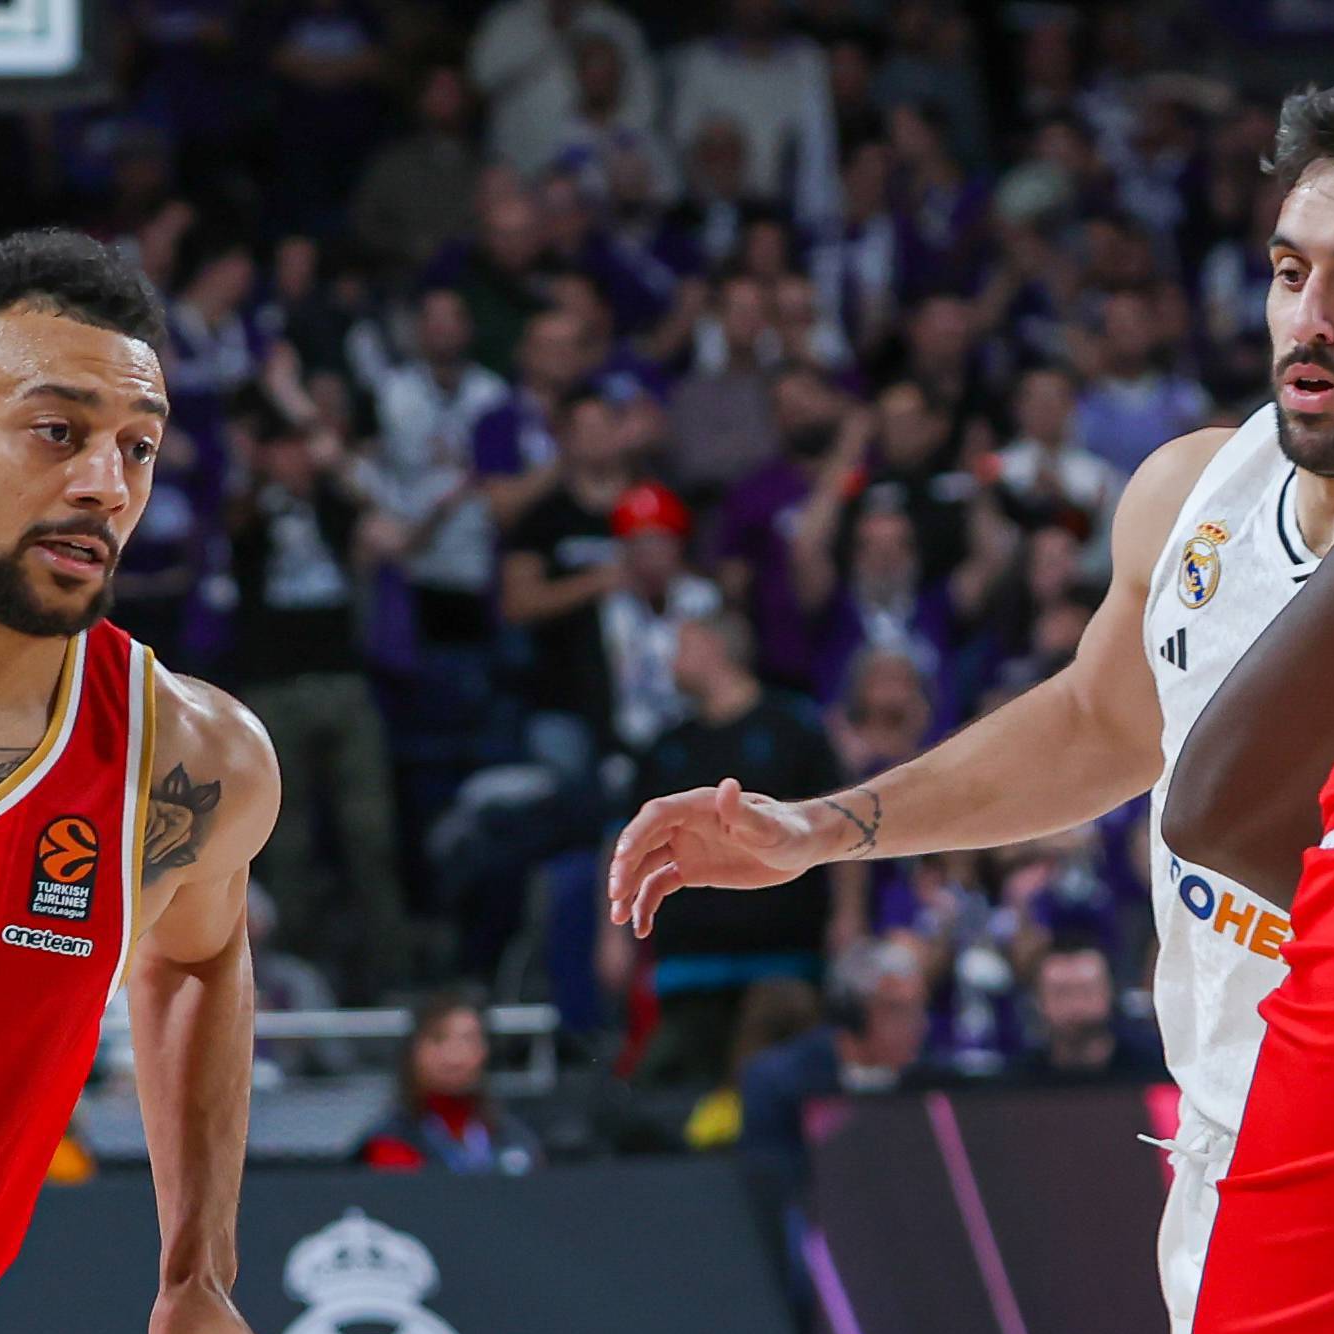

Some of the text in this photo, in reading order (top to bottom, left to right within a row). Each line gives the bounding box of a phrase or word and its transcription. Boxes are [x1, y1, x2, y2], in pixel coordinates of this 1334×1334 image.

[36, 880, 90, 898] TURKISH
[33, 892, 88, 909] AIRLINES
[31, 902, 87, 919] EuroLeague
[3, 926, 92, 956] oneteam
